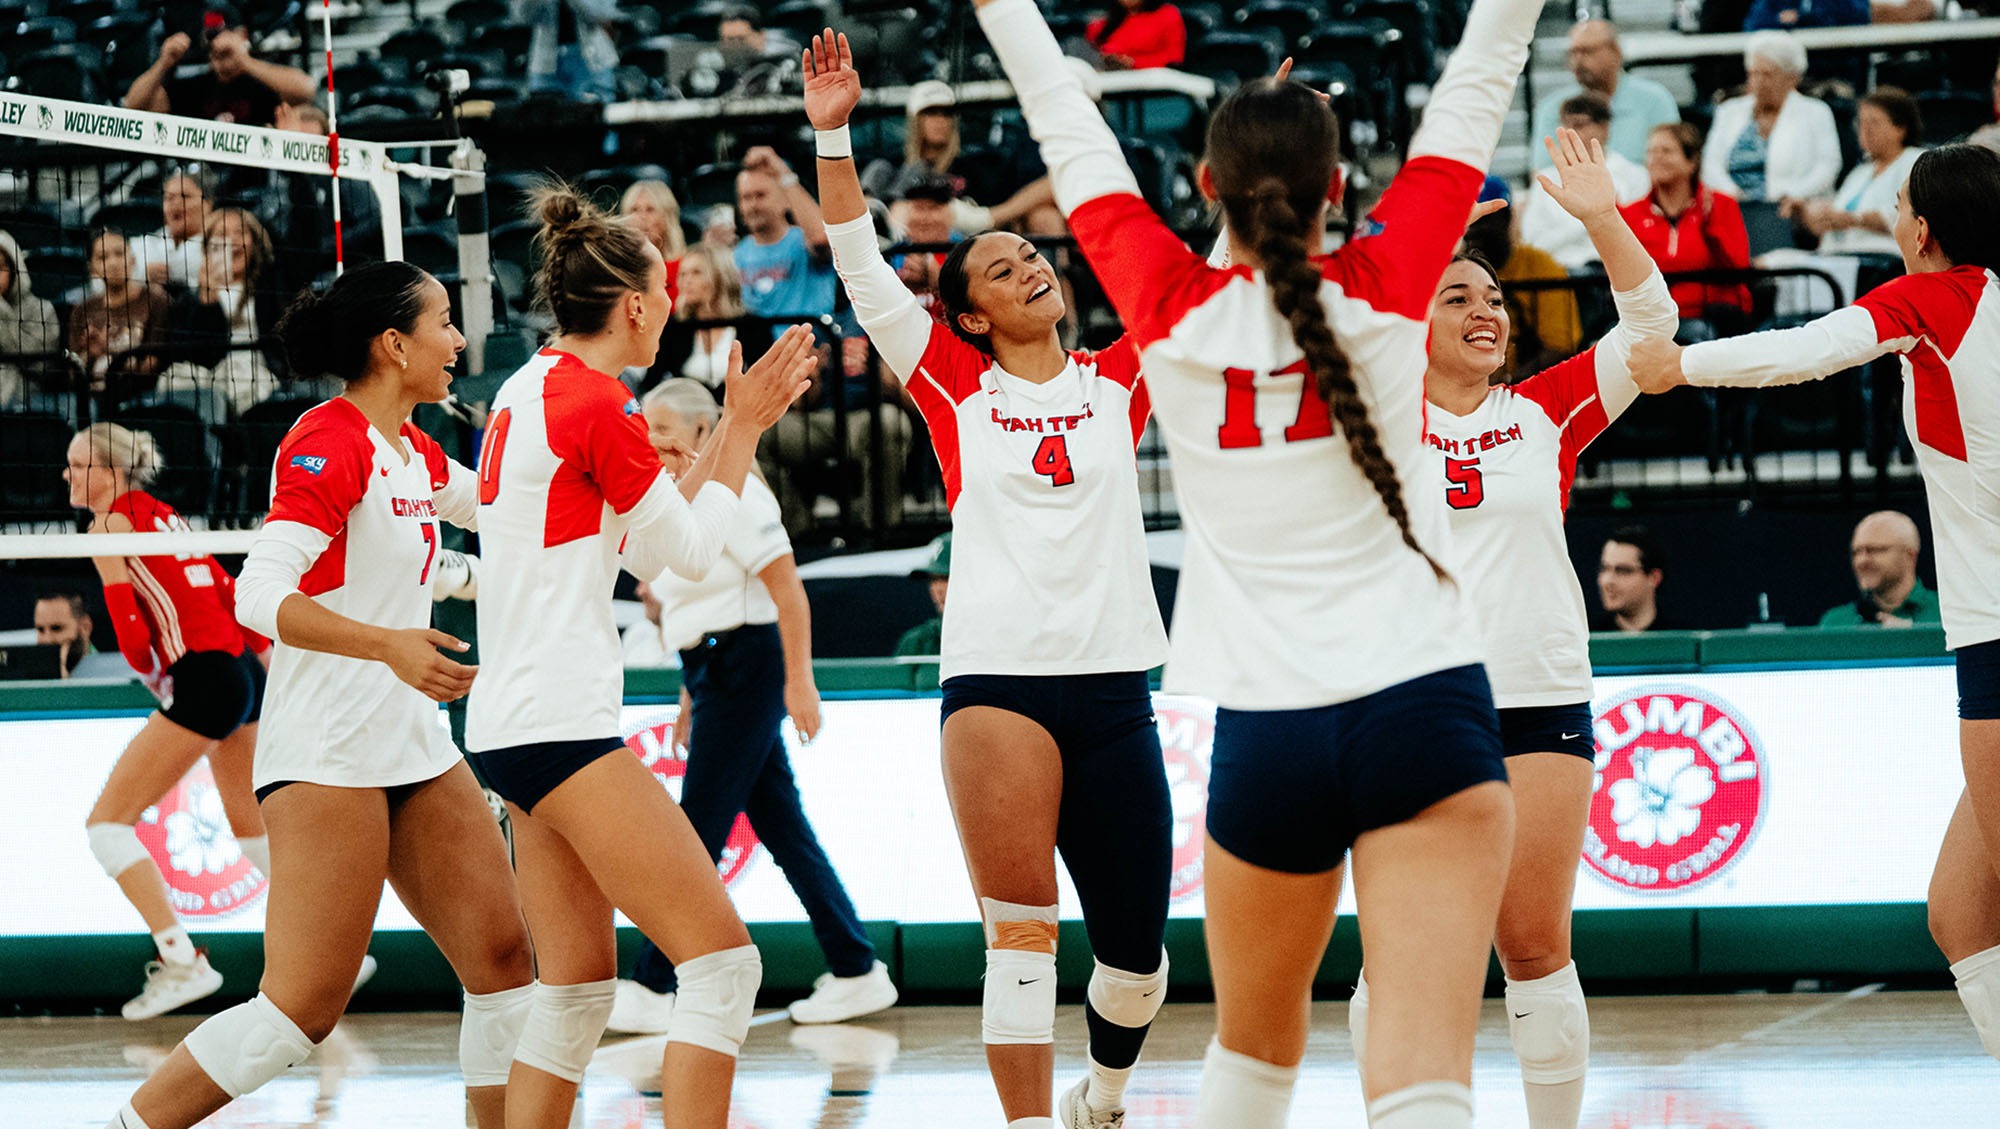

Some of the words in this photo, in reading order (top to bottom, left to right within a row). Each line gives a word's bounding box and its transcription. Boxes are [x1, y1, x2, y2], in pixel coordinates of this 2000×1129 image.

[0, 102, 27, 125] LEY
[64, 110, 144, 140] WOLVERINES
[176, 126, 207, 149] UTAH
[211, 131, 251, 154] VALLEY
[1046, 402, 1094, 432] TE
[1218, 358, 1334, 449] 17
[303, 456, 328, 469] SKY
[477, 406, 512, 506] 0
[1031, 433, 1075, 487] 4
[1427, 433, 1460, 455] AH
[1463, 423, 1523, 455] TECH
[391, 497, 423, 517] UTAH
[1445, 456, 1484, 510] 5
[419, 522, 436, 586] 7
